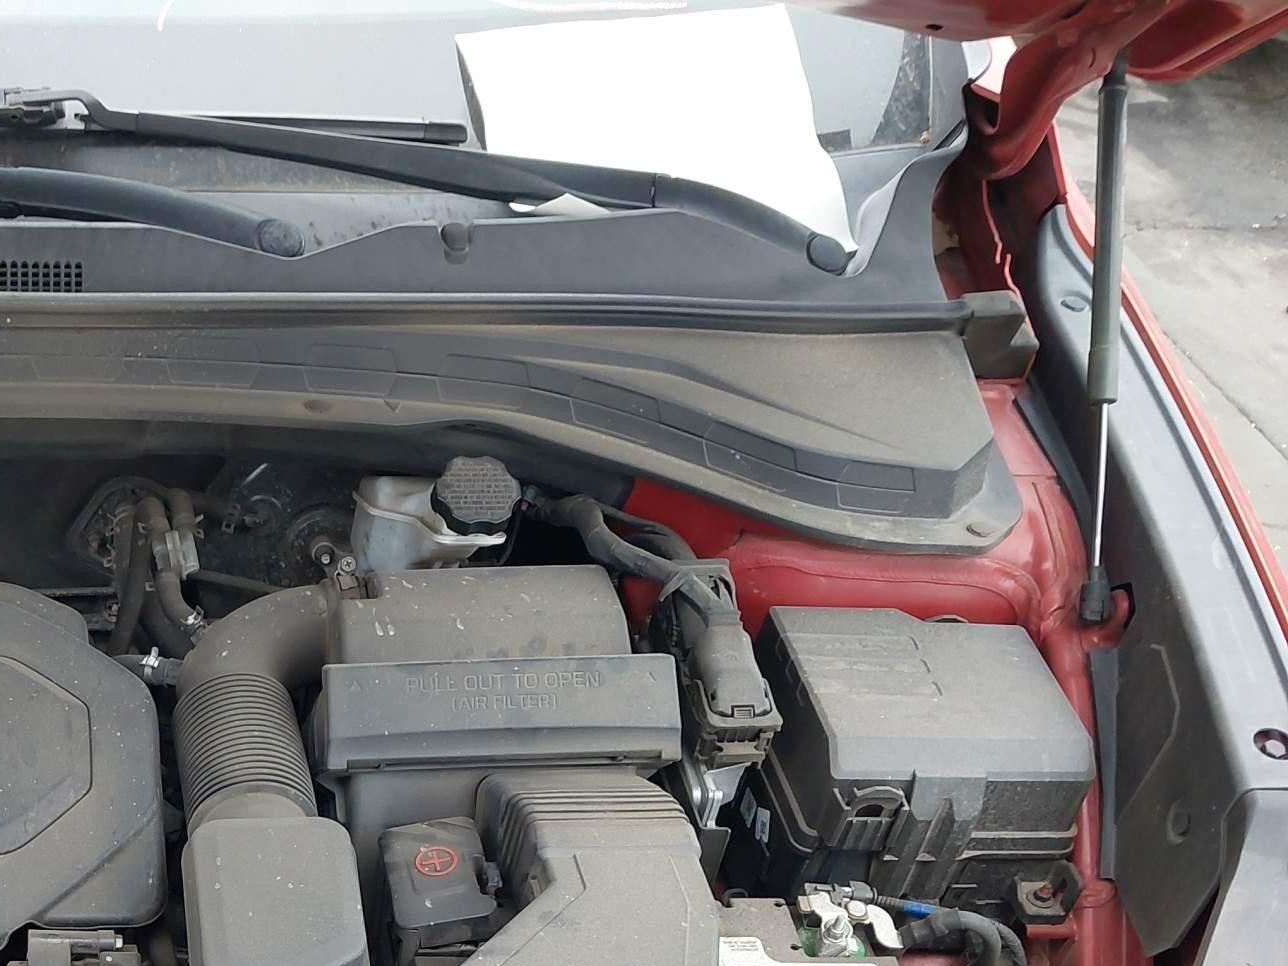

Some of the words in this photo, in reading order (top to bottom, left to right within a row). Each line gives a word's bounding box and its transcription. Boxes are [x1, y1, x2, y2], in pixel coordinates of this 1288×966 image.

[406, 675, 459, 693] PULL
[464, 674, 505, 691] OUT
[511, 672, 539, 689] TO
[544, 671, 601, 689] OPEN
